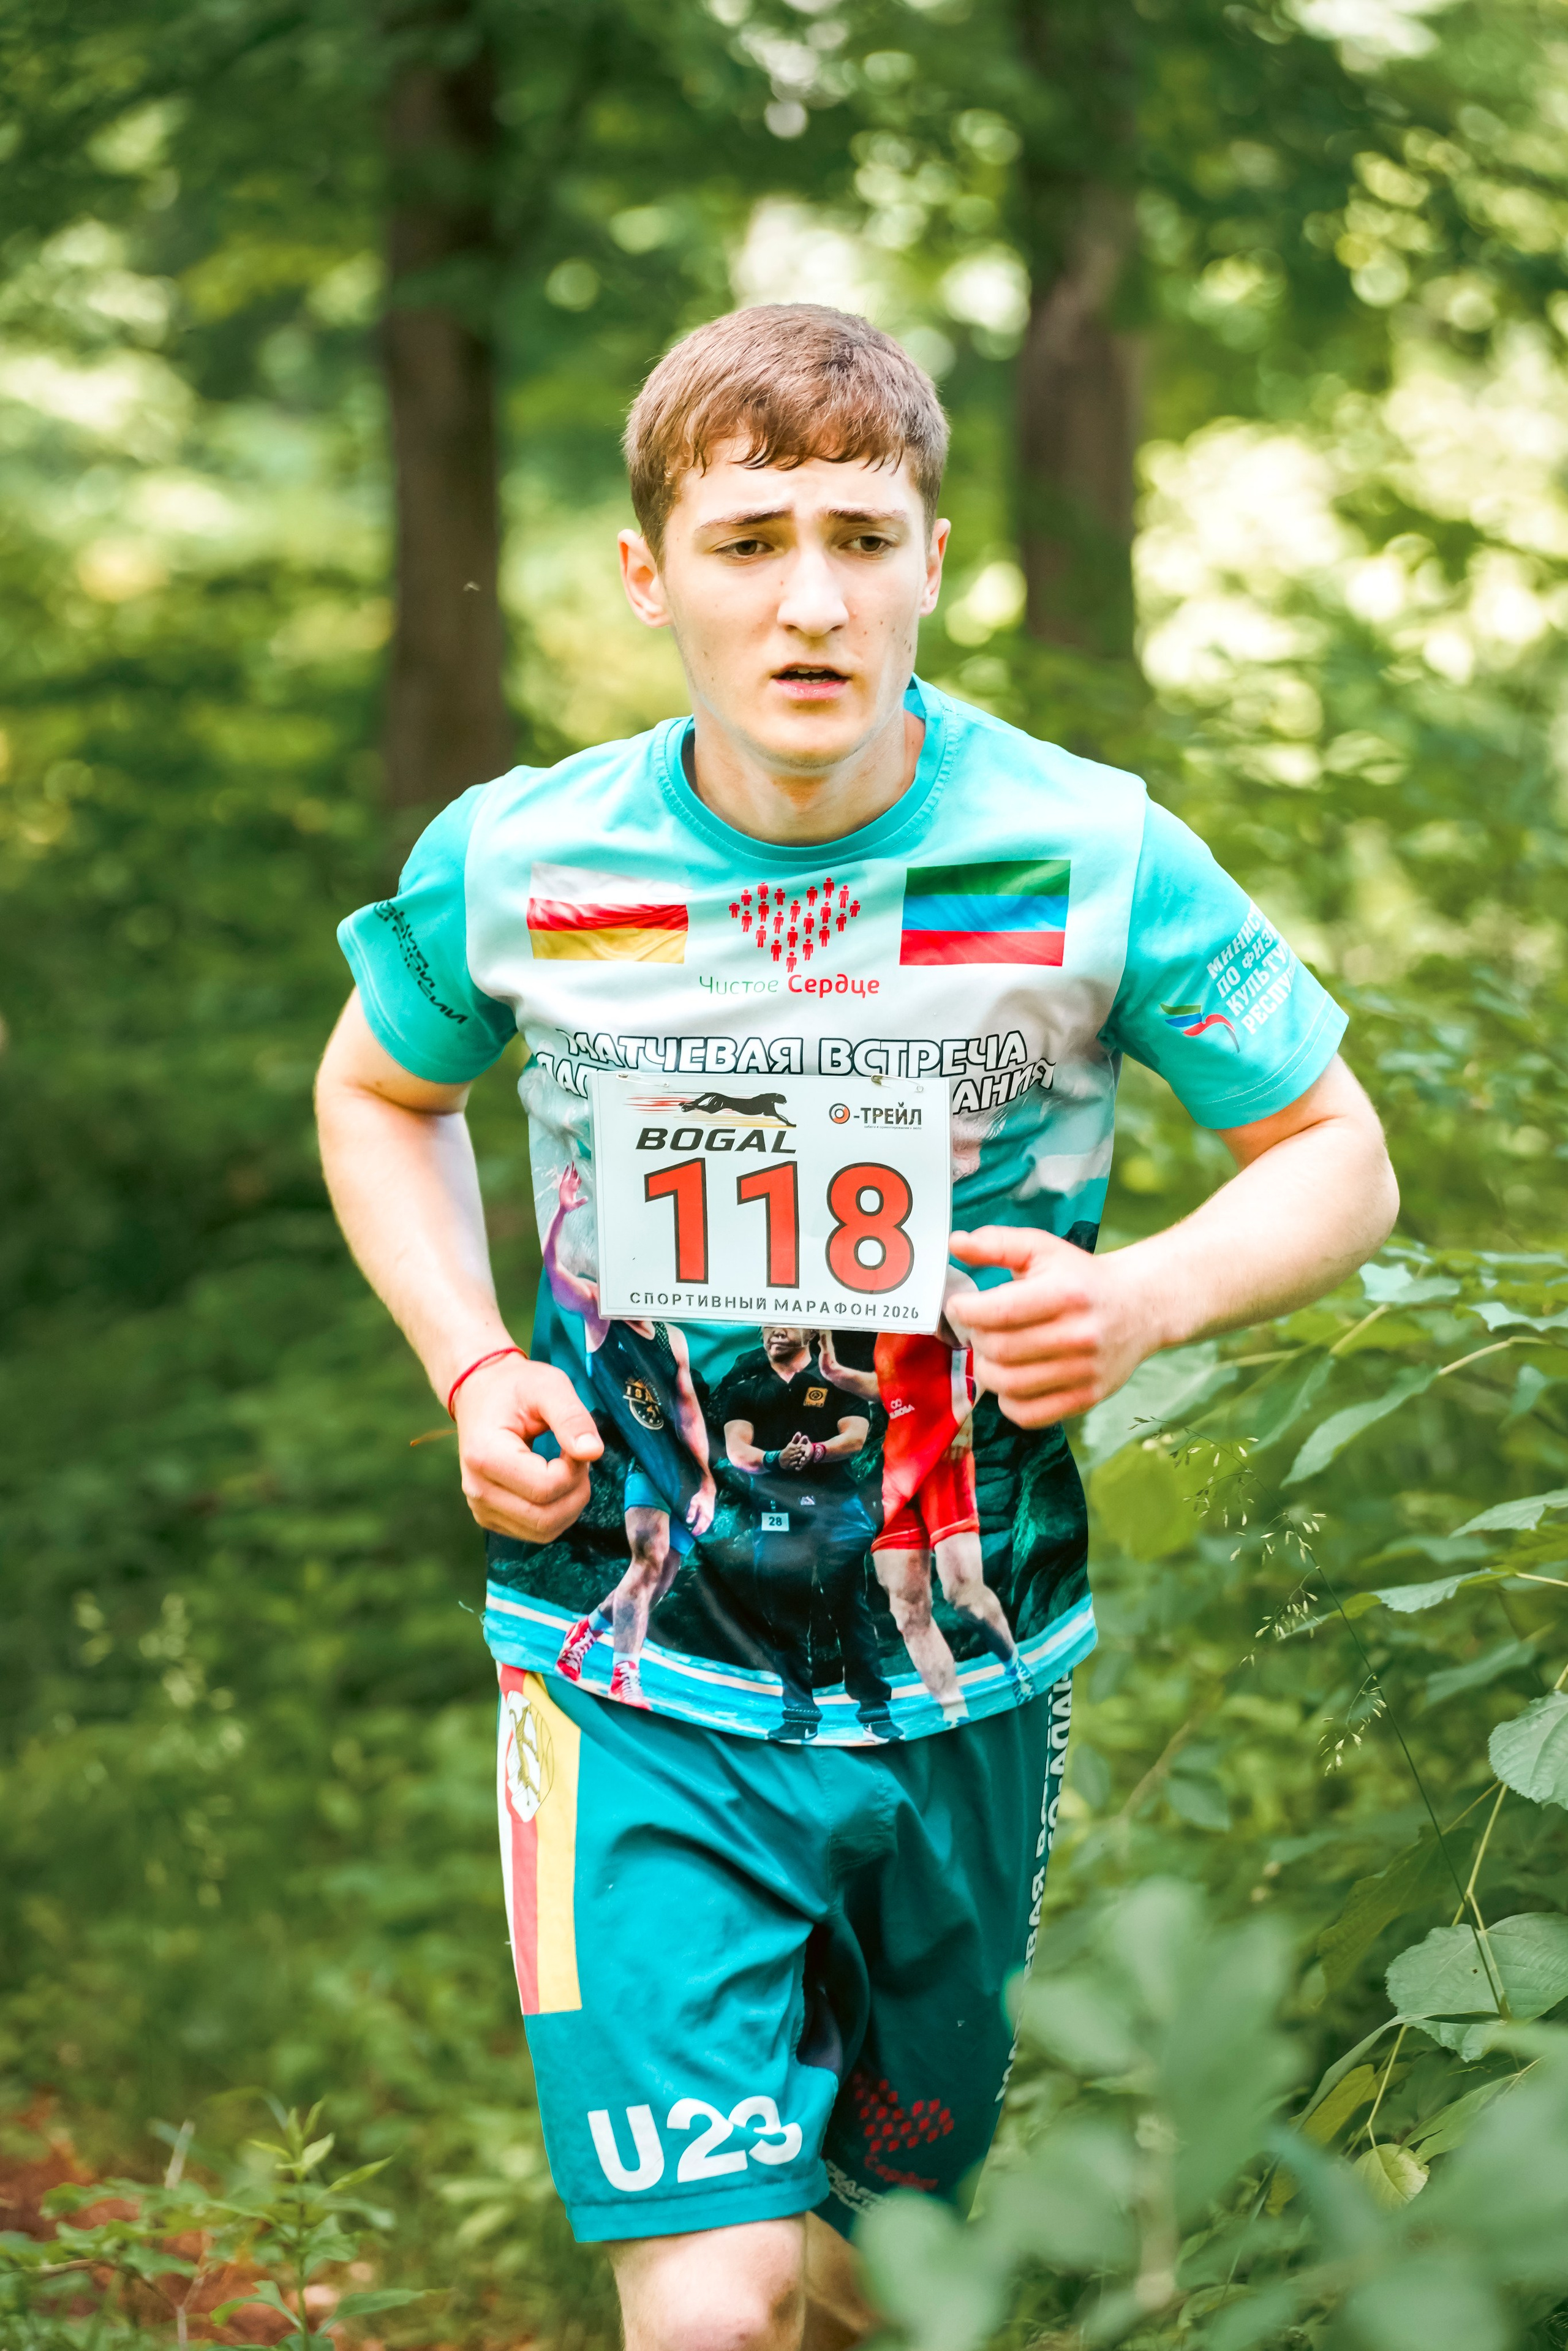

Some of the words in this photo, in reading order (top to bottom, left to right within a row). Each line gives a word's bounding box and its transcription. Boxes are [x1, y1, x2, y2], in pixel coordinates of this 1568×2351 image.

[1207, 907, 1265, 979] МИНИС
[699, 975, 779, 995] Чистое
[788, 973, 880, 999] Сердце
[1216, 965, 1241, 998] ПО
[555, 1028, 804, 1074] МАТЧЕВАЯ
[818, 1030, 1028, 1078] ВСТРЕЧА
[535, 1051, 612, 1100] ДАГ
[952, 1057, 1057, 1115] АНИЯ
[635, 1127, 797, 1154] BOGAL
[643, 1157, 915, 1295] 118
[630, 1291, 767, 1311] СПОРТИВНЫЙ
[774, 1298, 877, 1318] МАРАФОН
[883, 1304, 920, 1320] 2026
[768, 1515, 783, 1526] 28
[587, 2095, 803, 2192] U23
